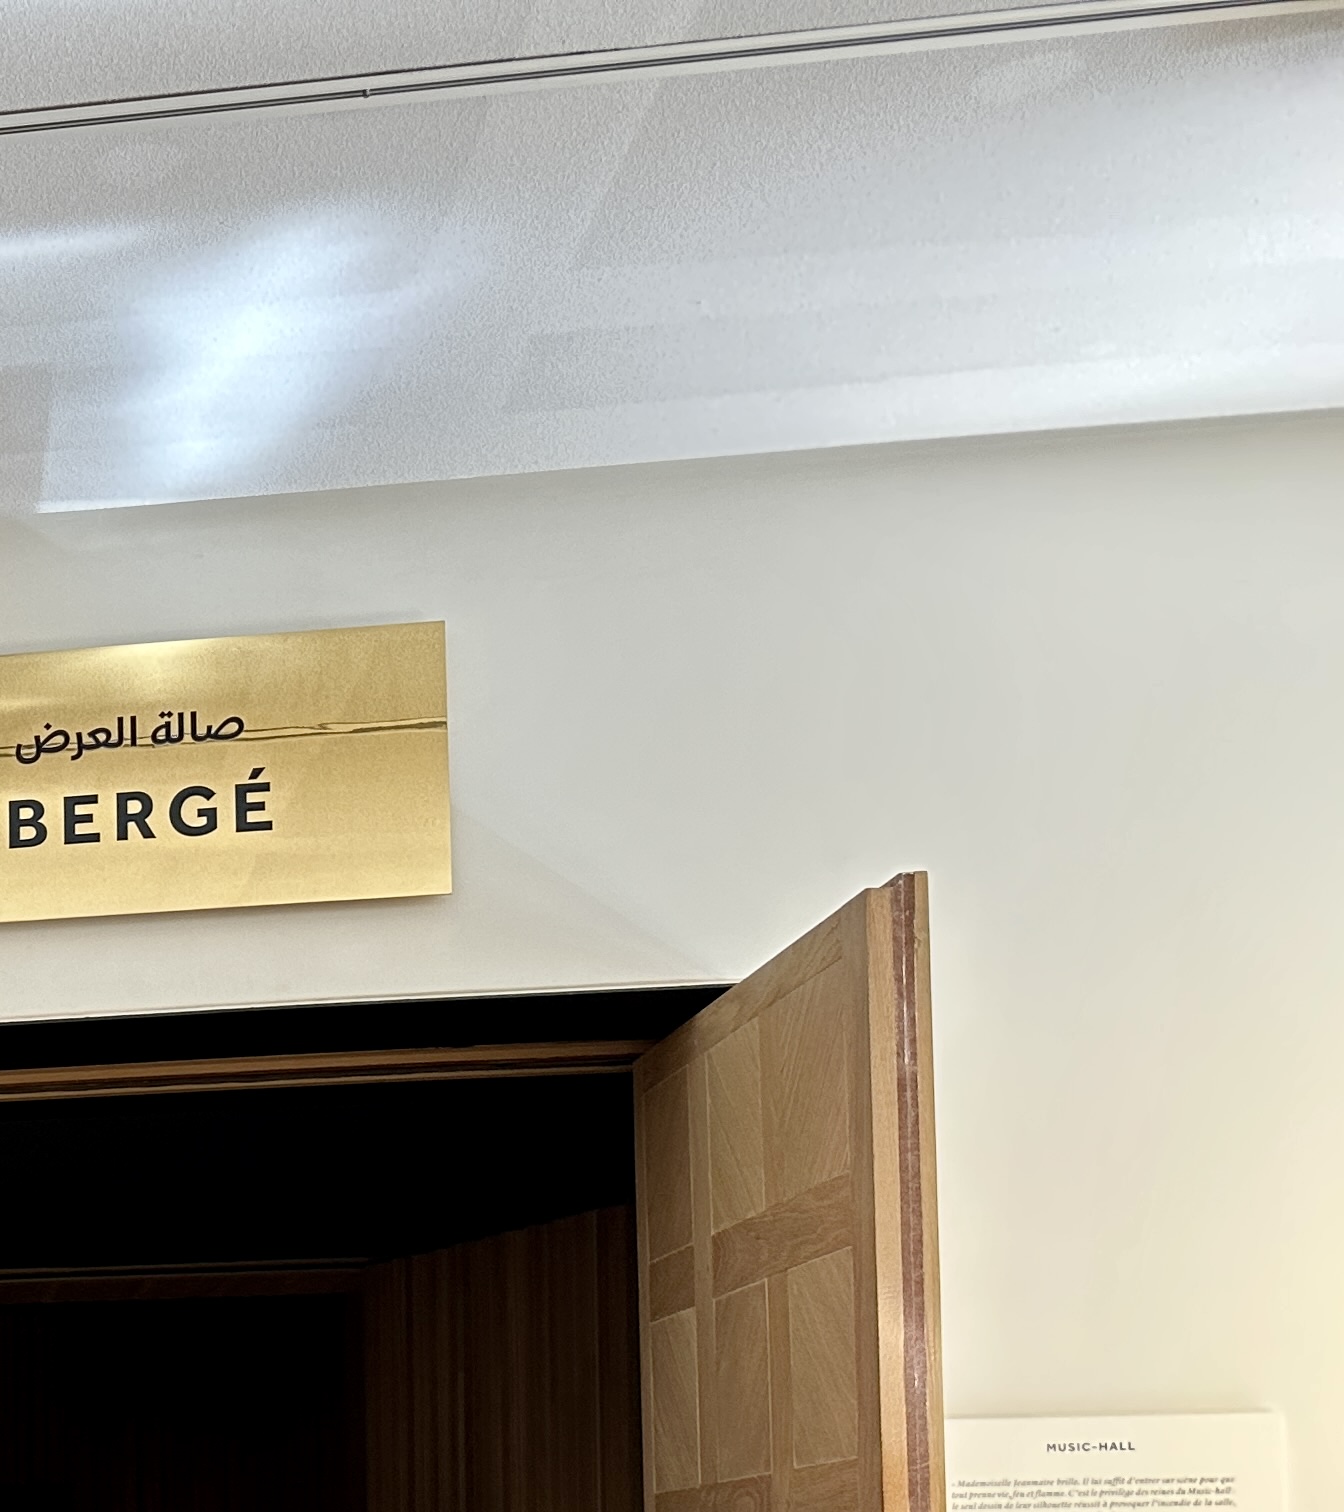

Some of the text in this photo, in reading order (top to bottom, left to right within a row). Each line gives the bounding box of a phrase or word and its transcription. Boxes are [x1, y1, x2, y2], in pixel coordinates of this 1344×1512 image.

[14, 709, 246, 766] صالة العرض
[8, 767, 275, 850] BERGÉ
[1046, 1442, 1136, 1453] MUSIC-HALL
